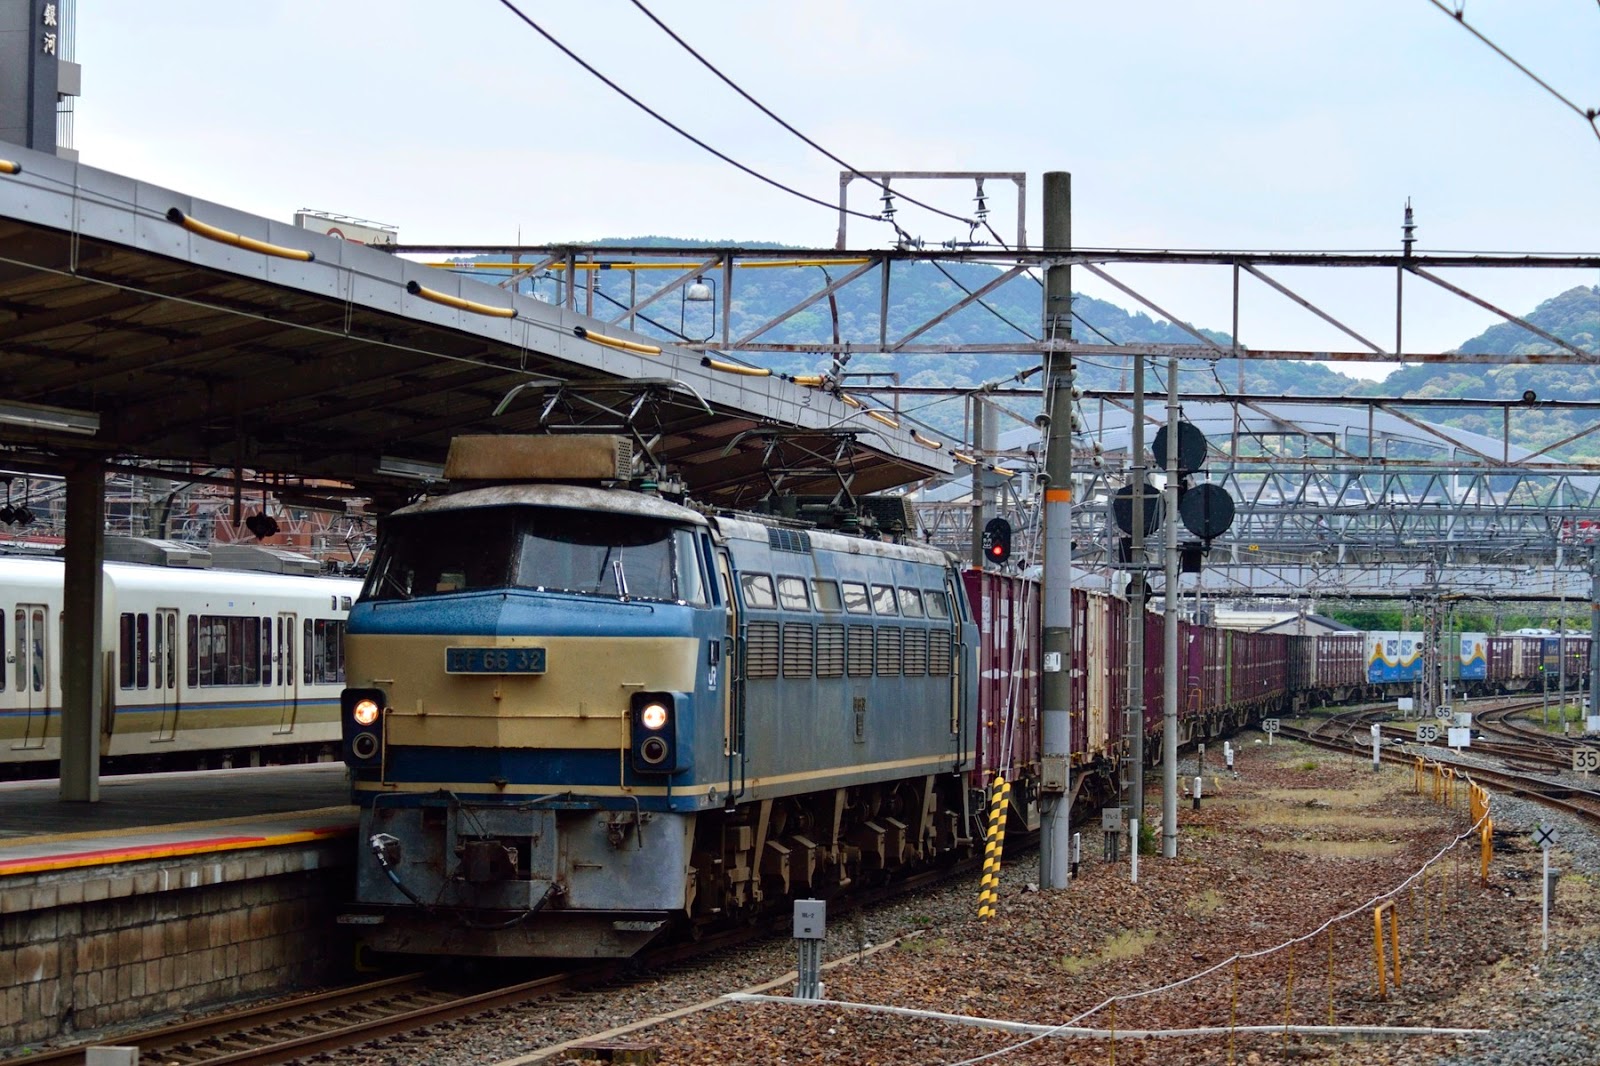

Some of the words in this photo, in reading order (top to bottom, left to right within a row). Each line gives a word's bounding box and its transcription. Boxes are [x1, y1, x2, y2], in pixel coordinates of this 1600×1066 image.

[43, 3, 57, 56] 銀河
[483, 651, 509, 670] 66
[516, 651, 541, 670] 32
[708, 666, 717, 686] JR
[1437, 707, 1451, 718] 35
[1264, 721, 1278, 731] 35
[1418, 726, 1436, 740] 35
[1575, 751, 1597, 768] 35
